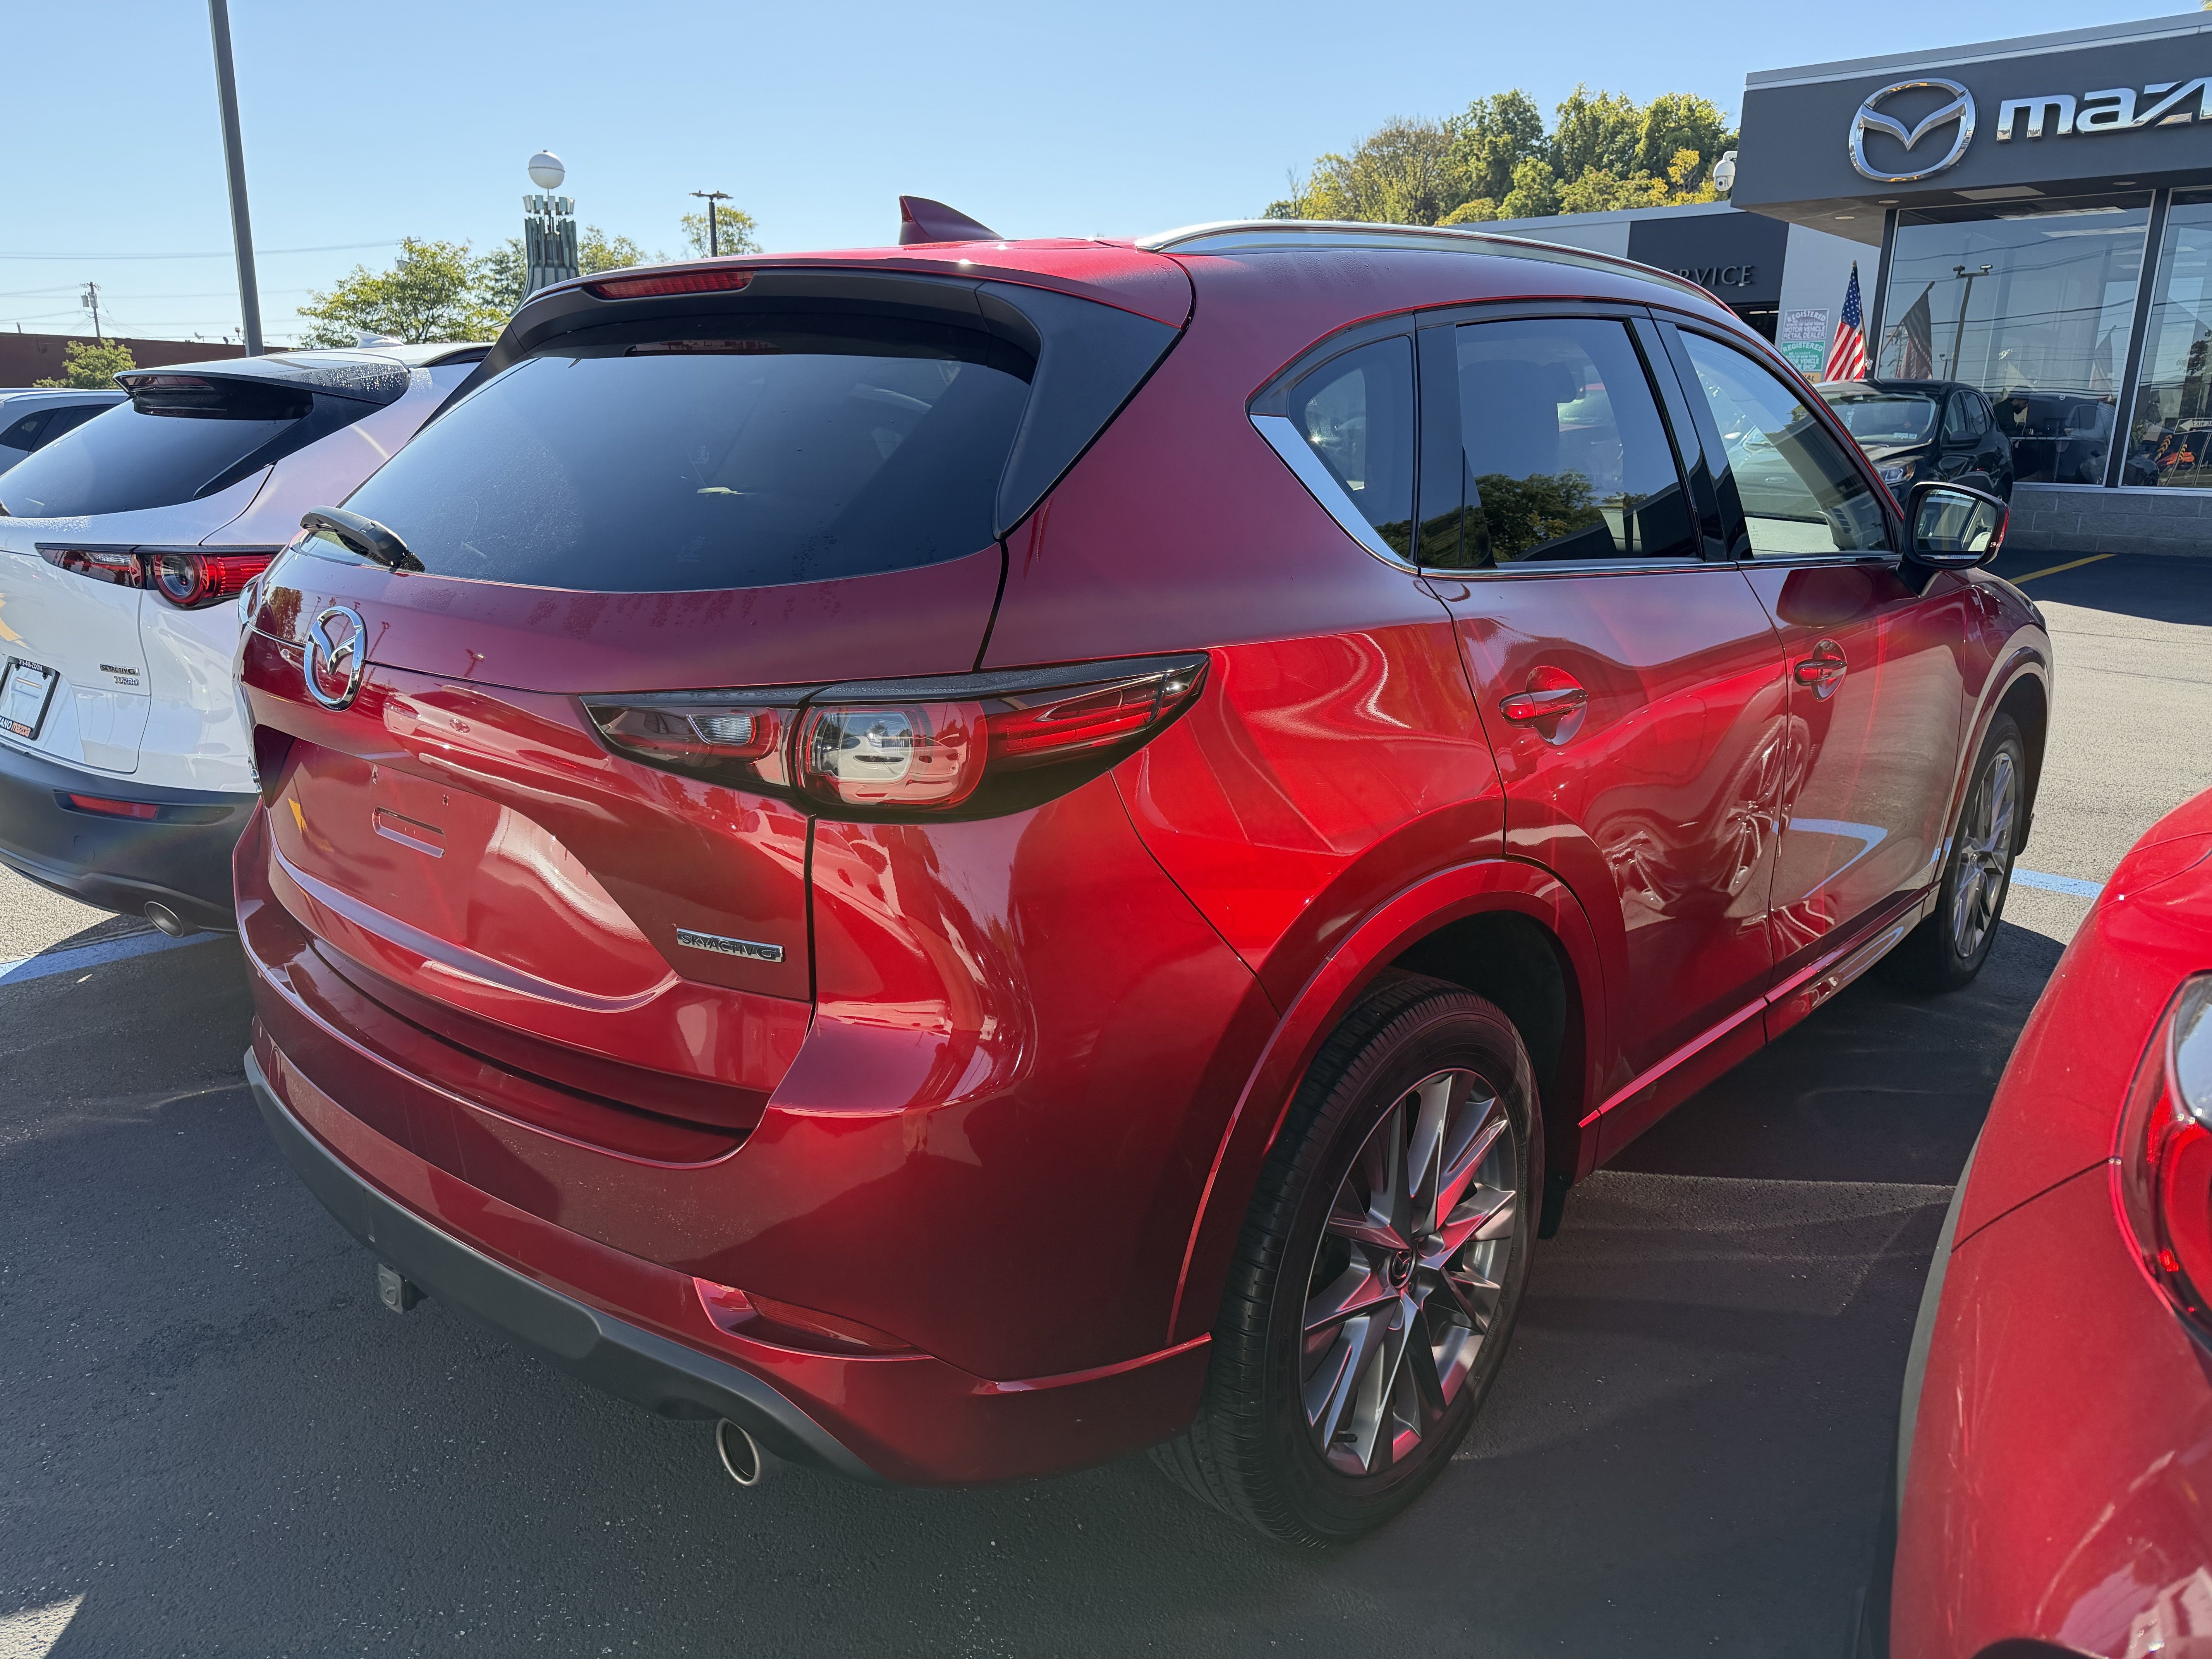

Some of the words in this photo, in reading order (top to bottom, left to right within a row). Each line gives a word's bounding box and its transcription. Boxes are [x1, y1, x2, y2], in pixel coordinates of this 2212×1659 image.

[1666, 265, 1752, 285] RVICE
[1787, 311, 1826, 322] REGISTERED
[1783, 342, 1823, 353] REGISTERED
[114, 676, 139, 686] TURBO
